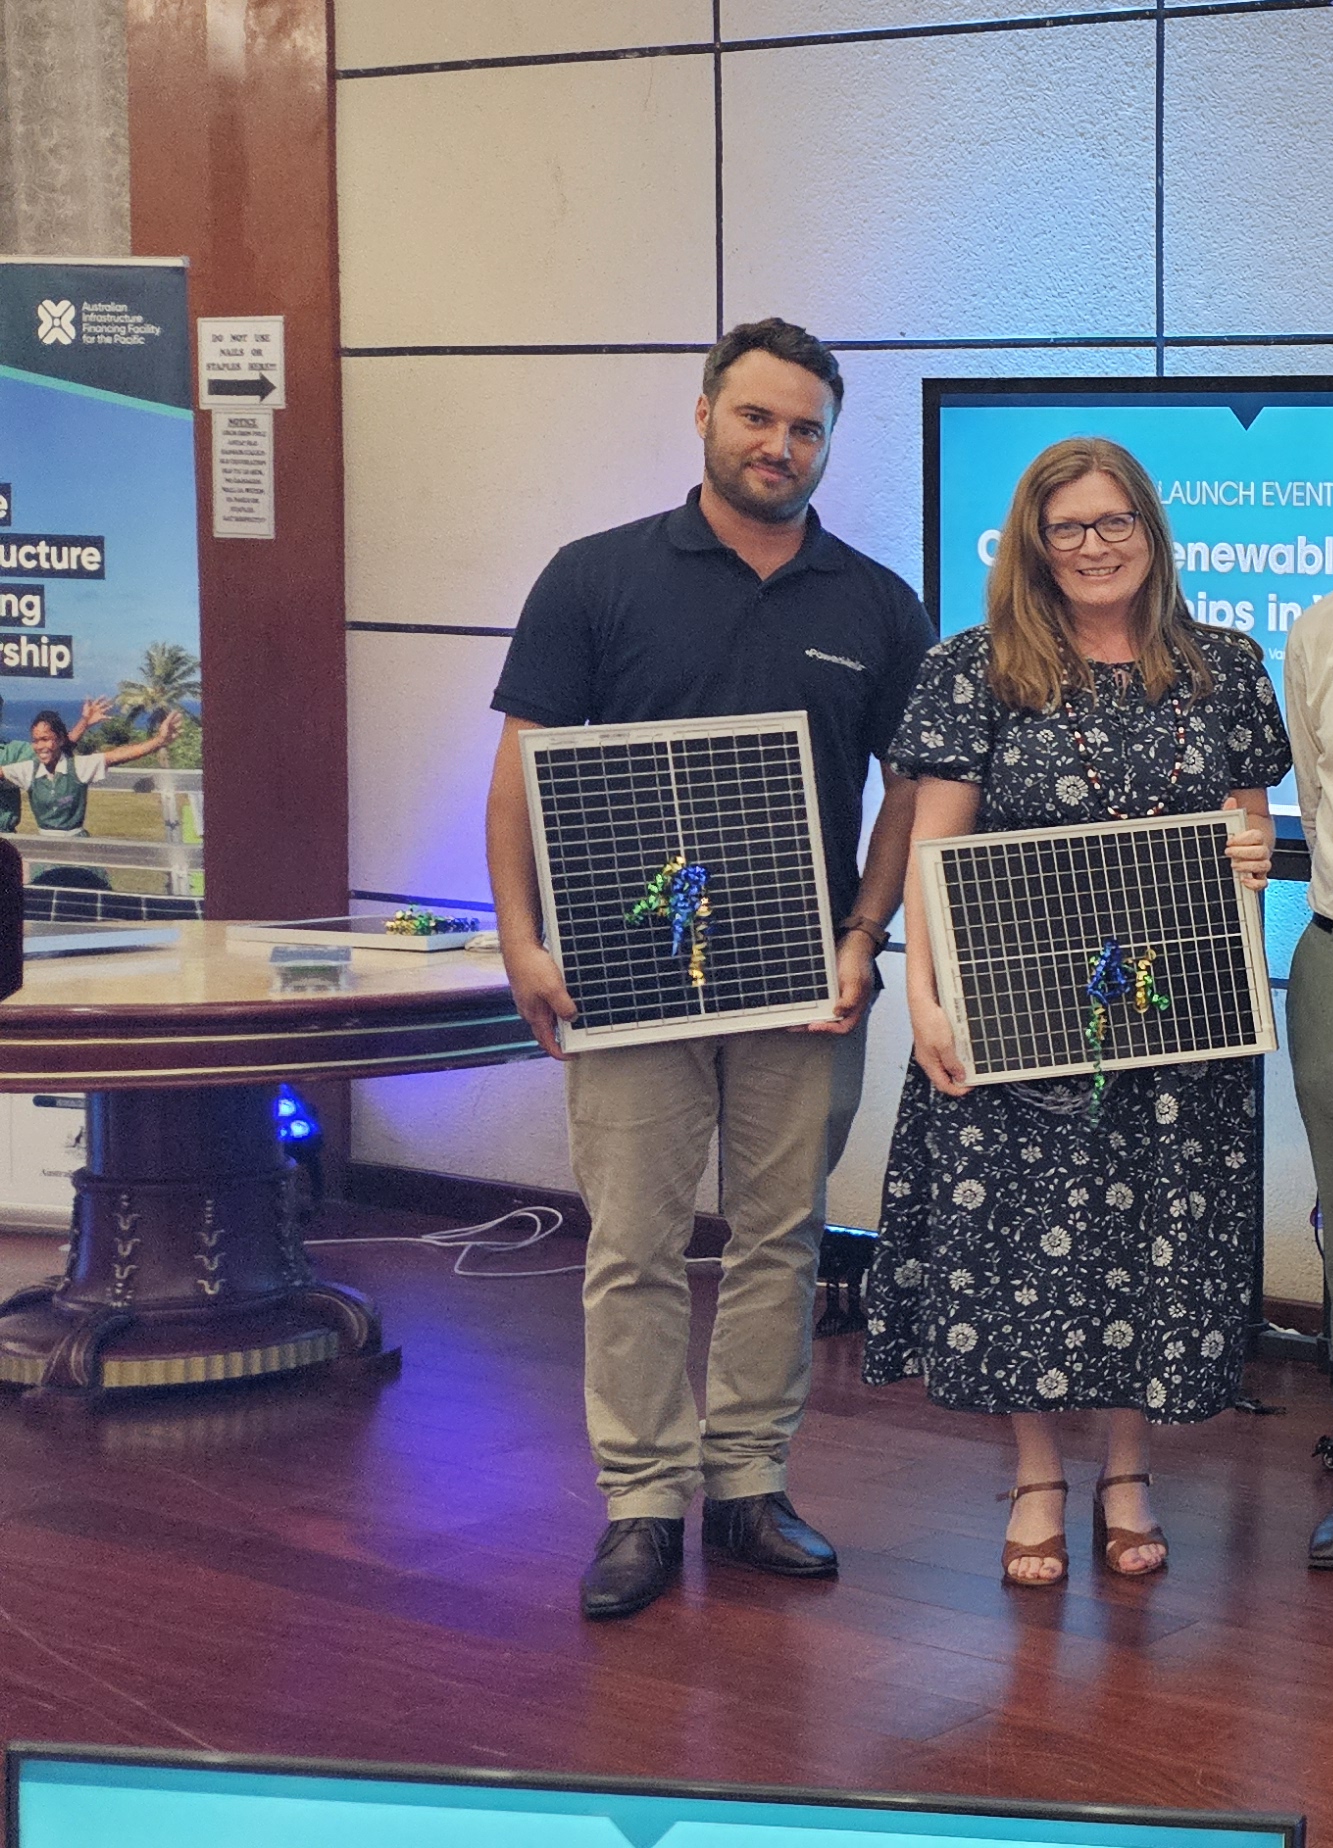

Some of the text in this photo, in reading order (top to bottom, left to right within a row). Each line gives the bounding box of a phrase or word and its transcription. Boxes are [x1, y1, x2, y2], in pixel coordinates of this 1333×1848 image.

[82, 302, 128, 312] Australian
[82, 313, 144, 323] Infrastructure
[82, 324, 161, 336] Financing Facility
[82, 334, 145, 345] for the Pacific
[212, 334, 271, 342] DO NOT USE
[220, 348, 263, 357] NAILS OR
[1158, 480, 1255, 506] LAUNCH
